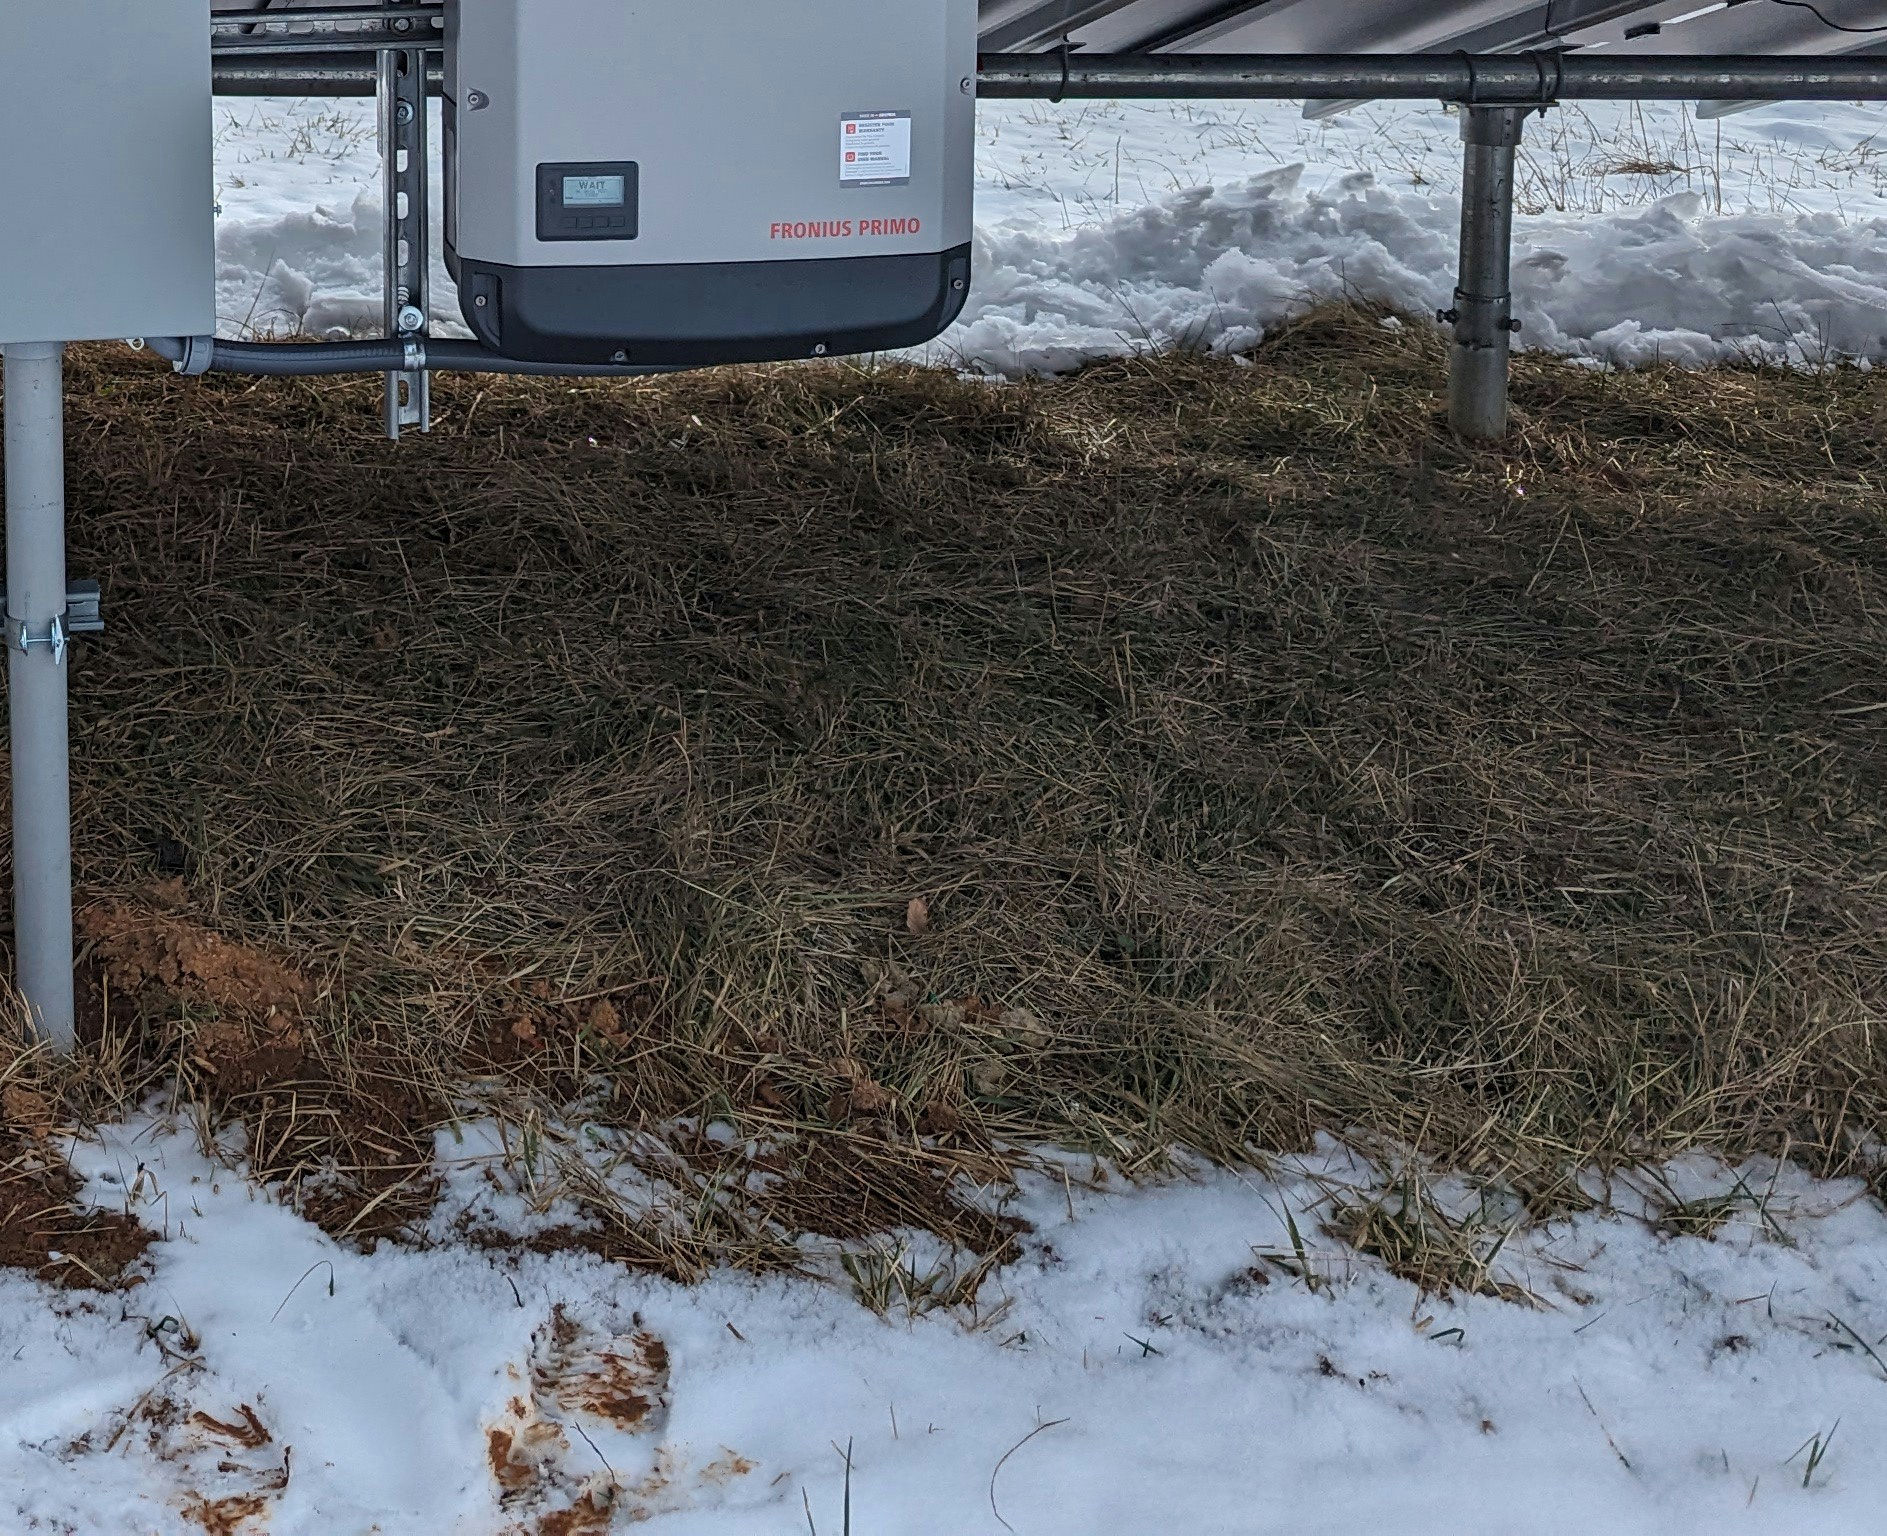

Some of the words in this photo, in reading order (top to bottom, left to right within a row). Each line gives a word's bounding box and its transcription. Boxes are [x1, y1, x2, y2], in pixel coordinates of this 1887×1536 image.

[578, 181, 606, 190] WAIT
[769, 220, 852, 240] FRONIUS
[858, 217, 921, 236] PRIMO
